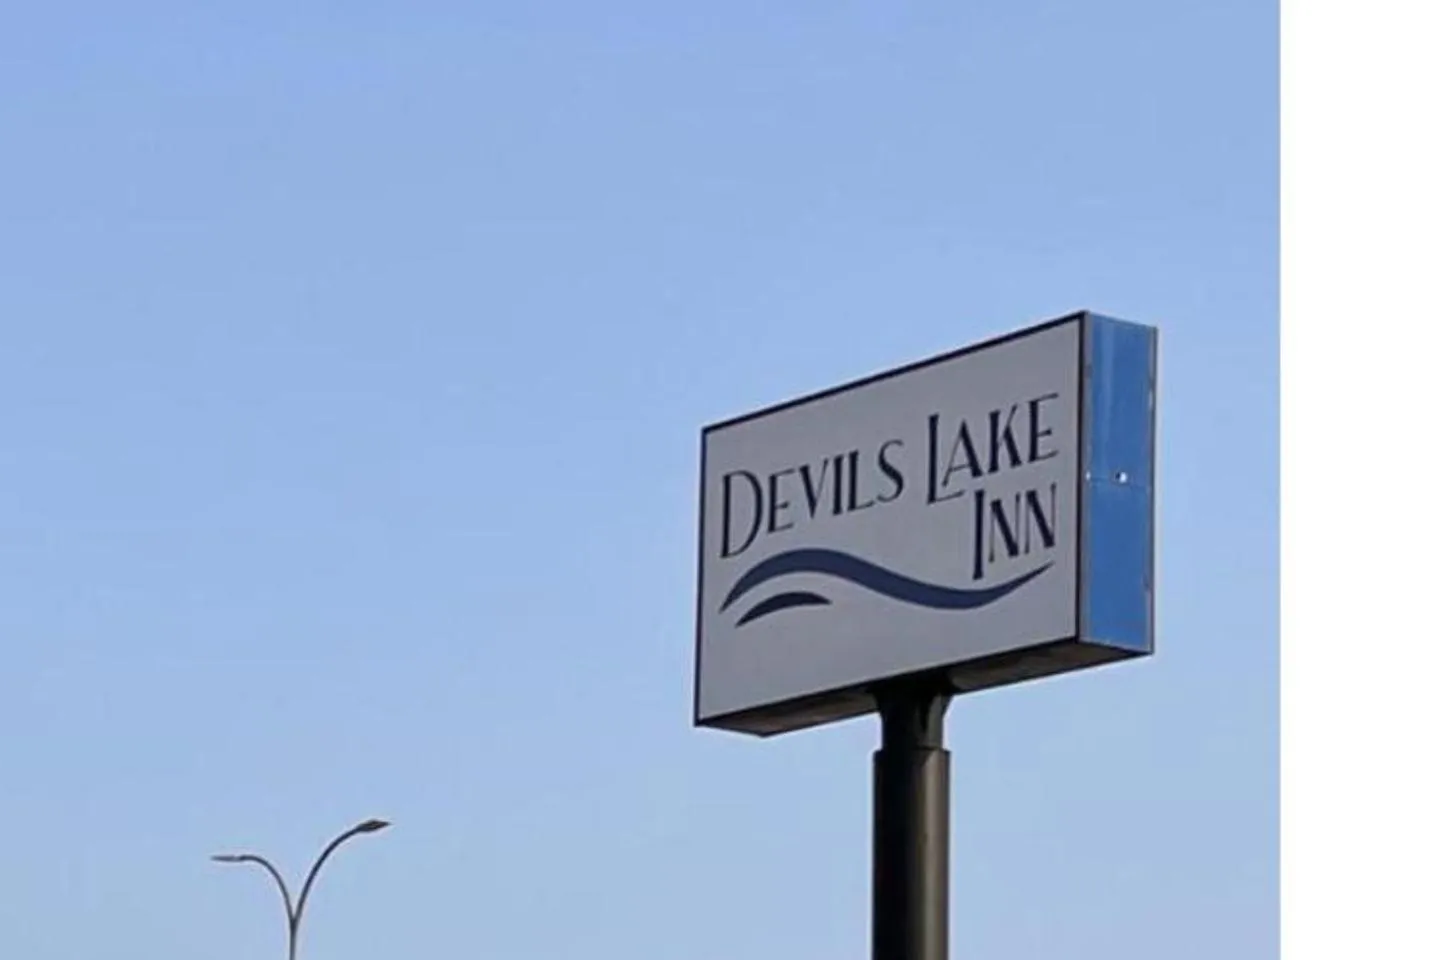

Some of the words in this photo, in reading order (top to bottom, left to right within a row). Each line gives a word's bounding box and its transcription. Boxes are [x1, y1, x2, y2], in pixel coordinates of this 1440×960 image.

[720, 439, 904, 559] DEVILS
[926, 392, 1060, 505] LAKE
[972, 482, 1058, 581] INN
